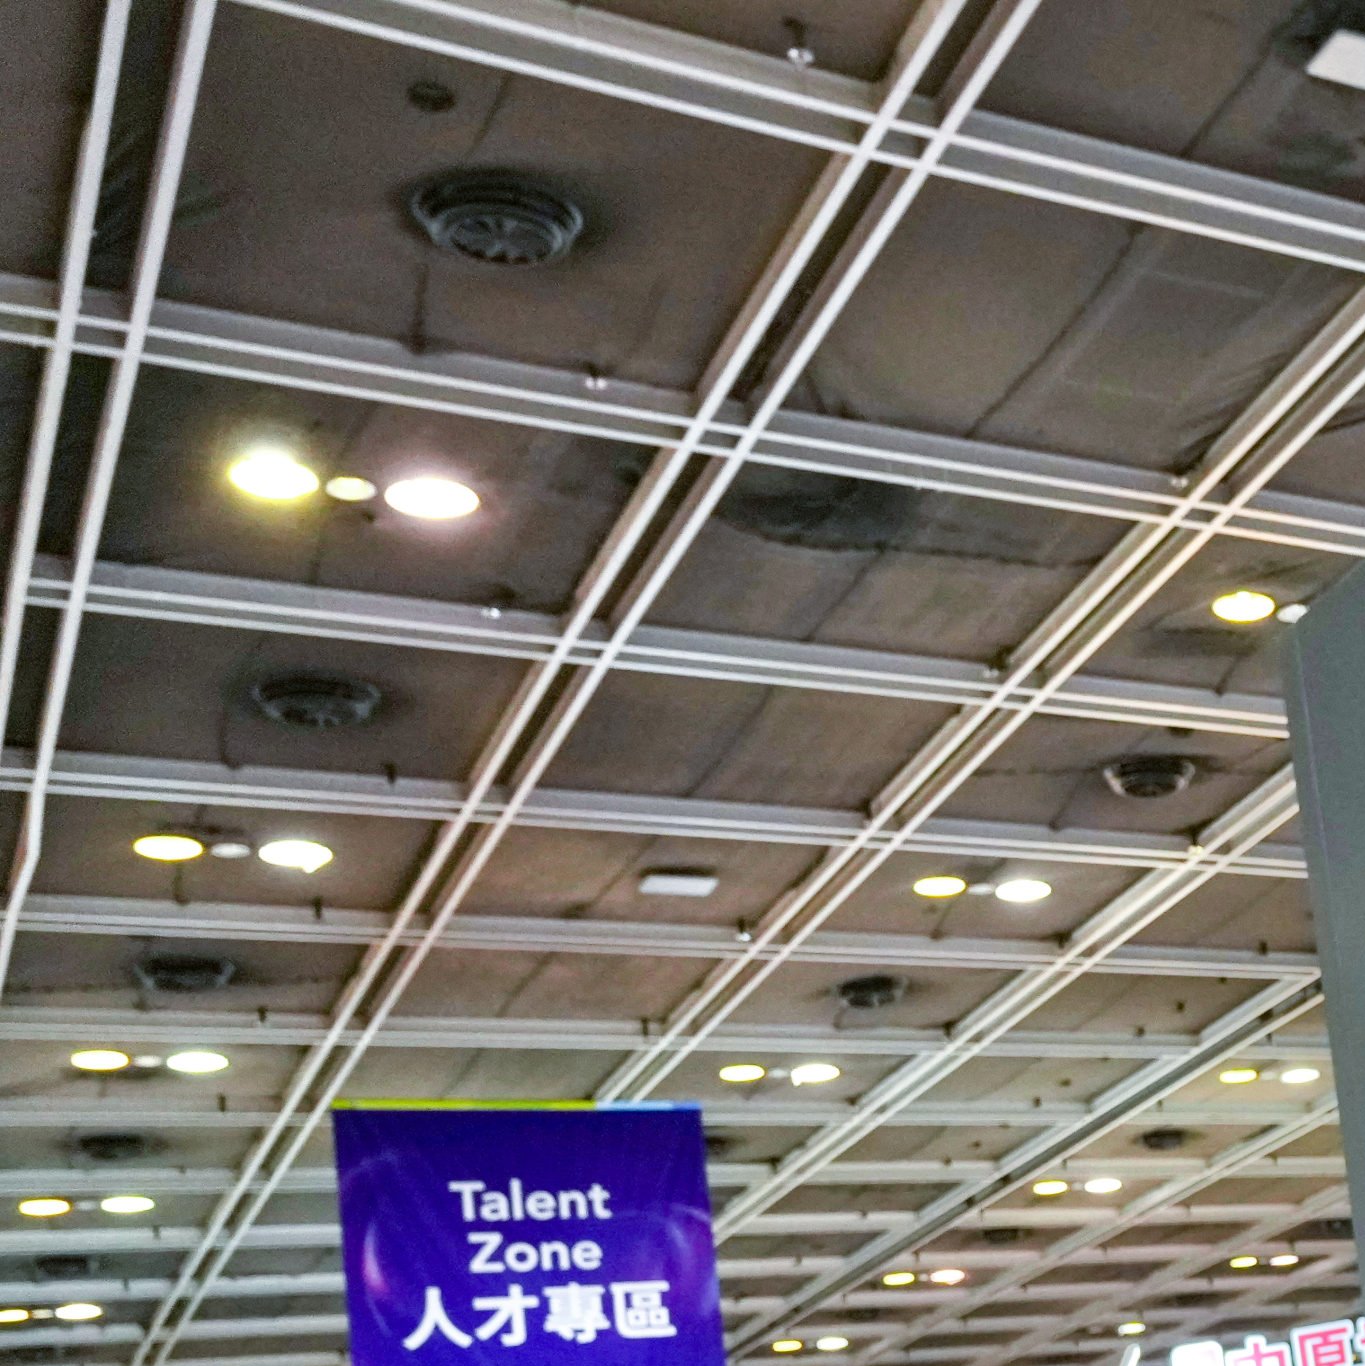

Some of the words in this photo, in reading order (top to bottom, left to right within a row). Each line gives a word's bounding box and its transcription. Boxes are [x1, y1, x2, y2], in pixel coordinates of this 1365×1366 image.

[448, 1177, 613, 1221] Talent
[467, 1231, 603, 1274] Zone
[402, 1280, 677, 1350] 人才專區
